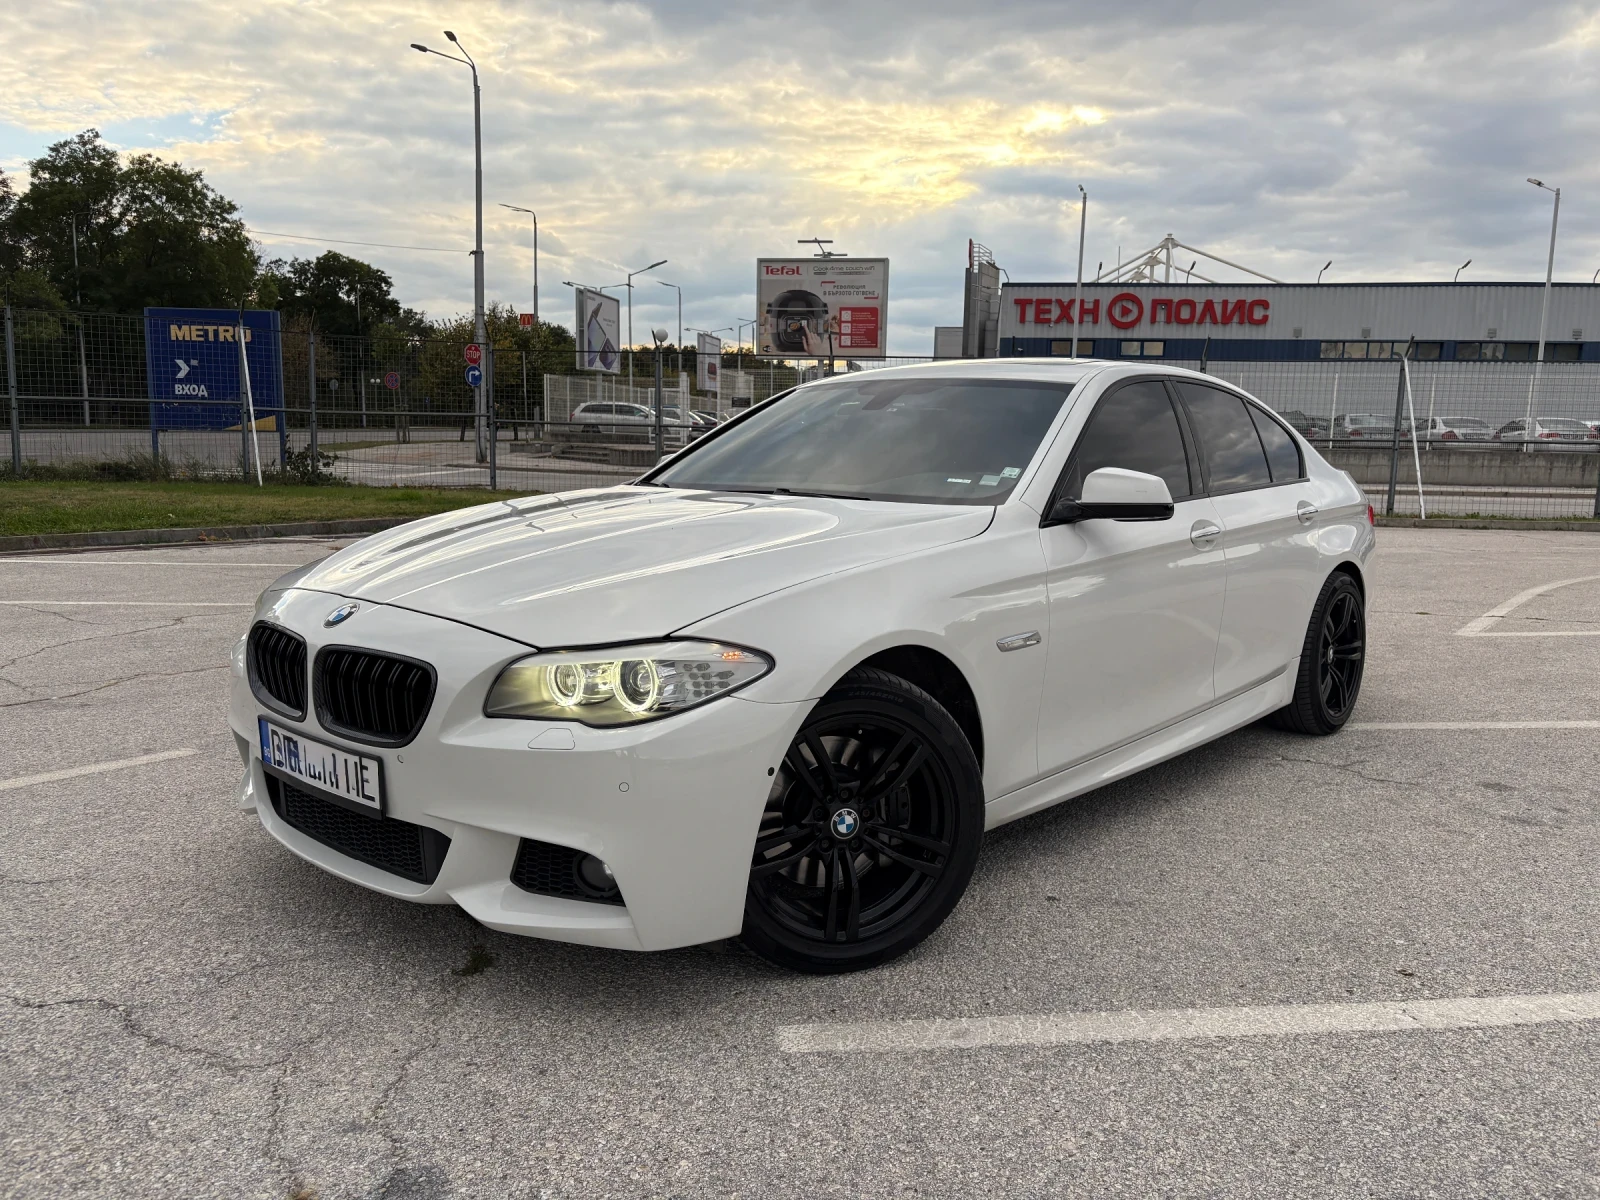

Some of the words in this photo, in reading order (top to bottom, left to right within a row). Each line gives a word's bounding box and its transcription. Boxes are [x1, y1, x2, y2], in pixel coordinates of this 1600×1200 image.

[763, 265, 802, 276] Tefal
[170, 324, 252, 342] METRO
[466, 350, 481, 359] STOP
[174, 384, 208, 398] ВХОД
